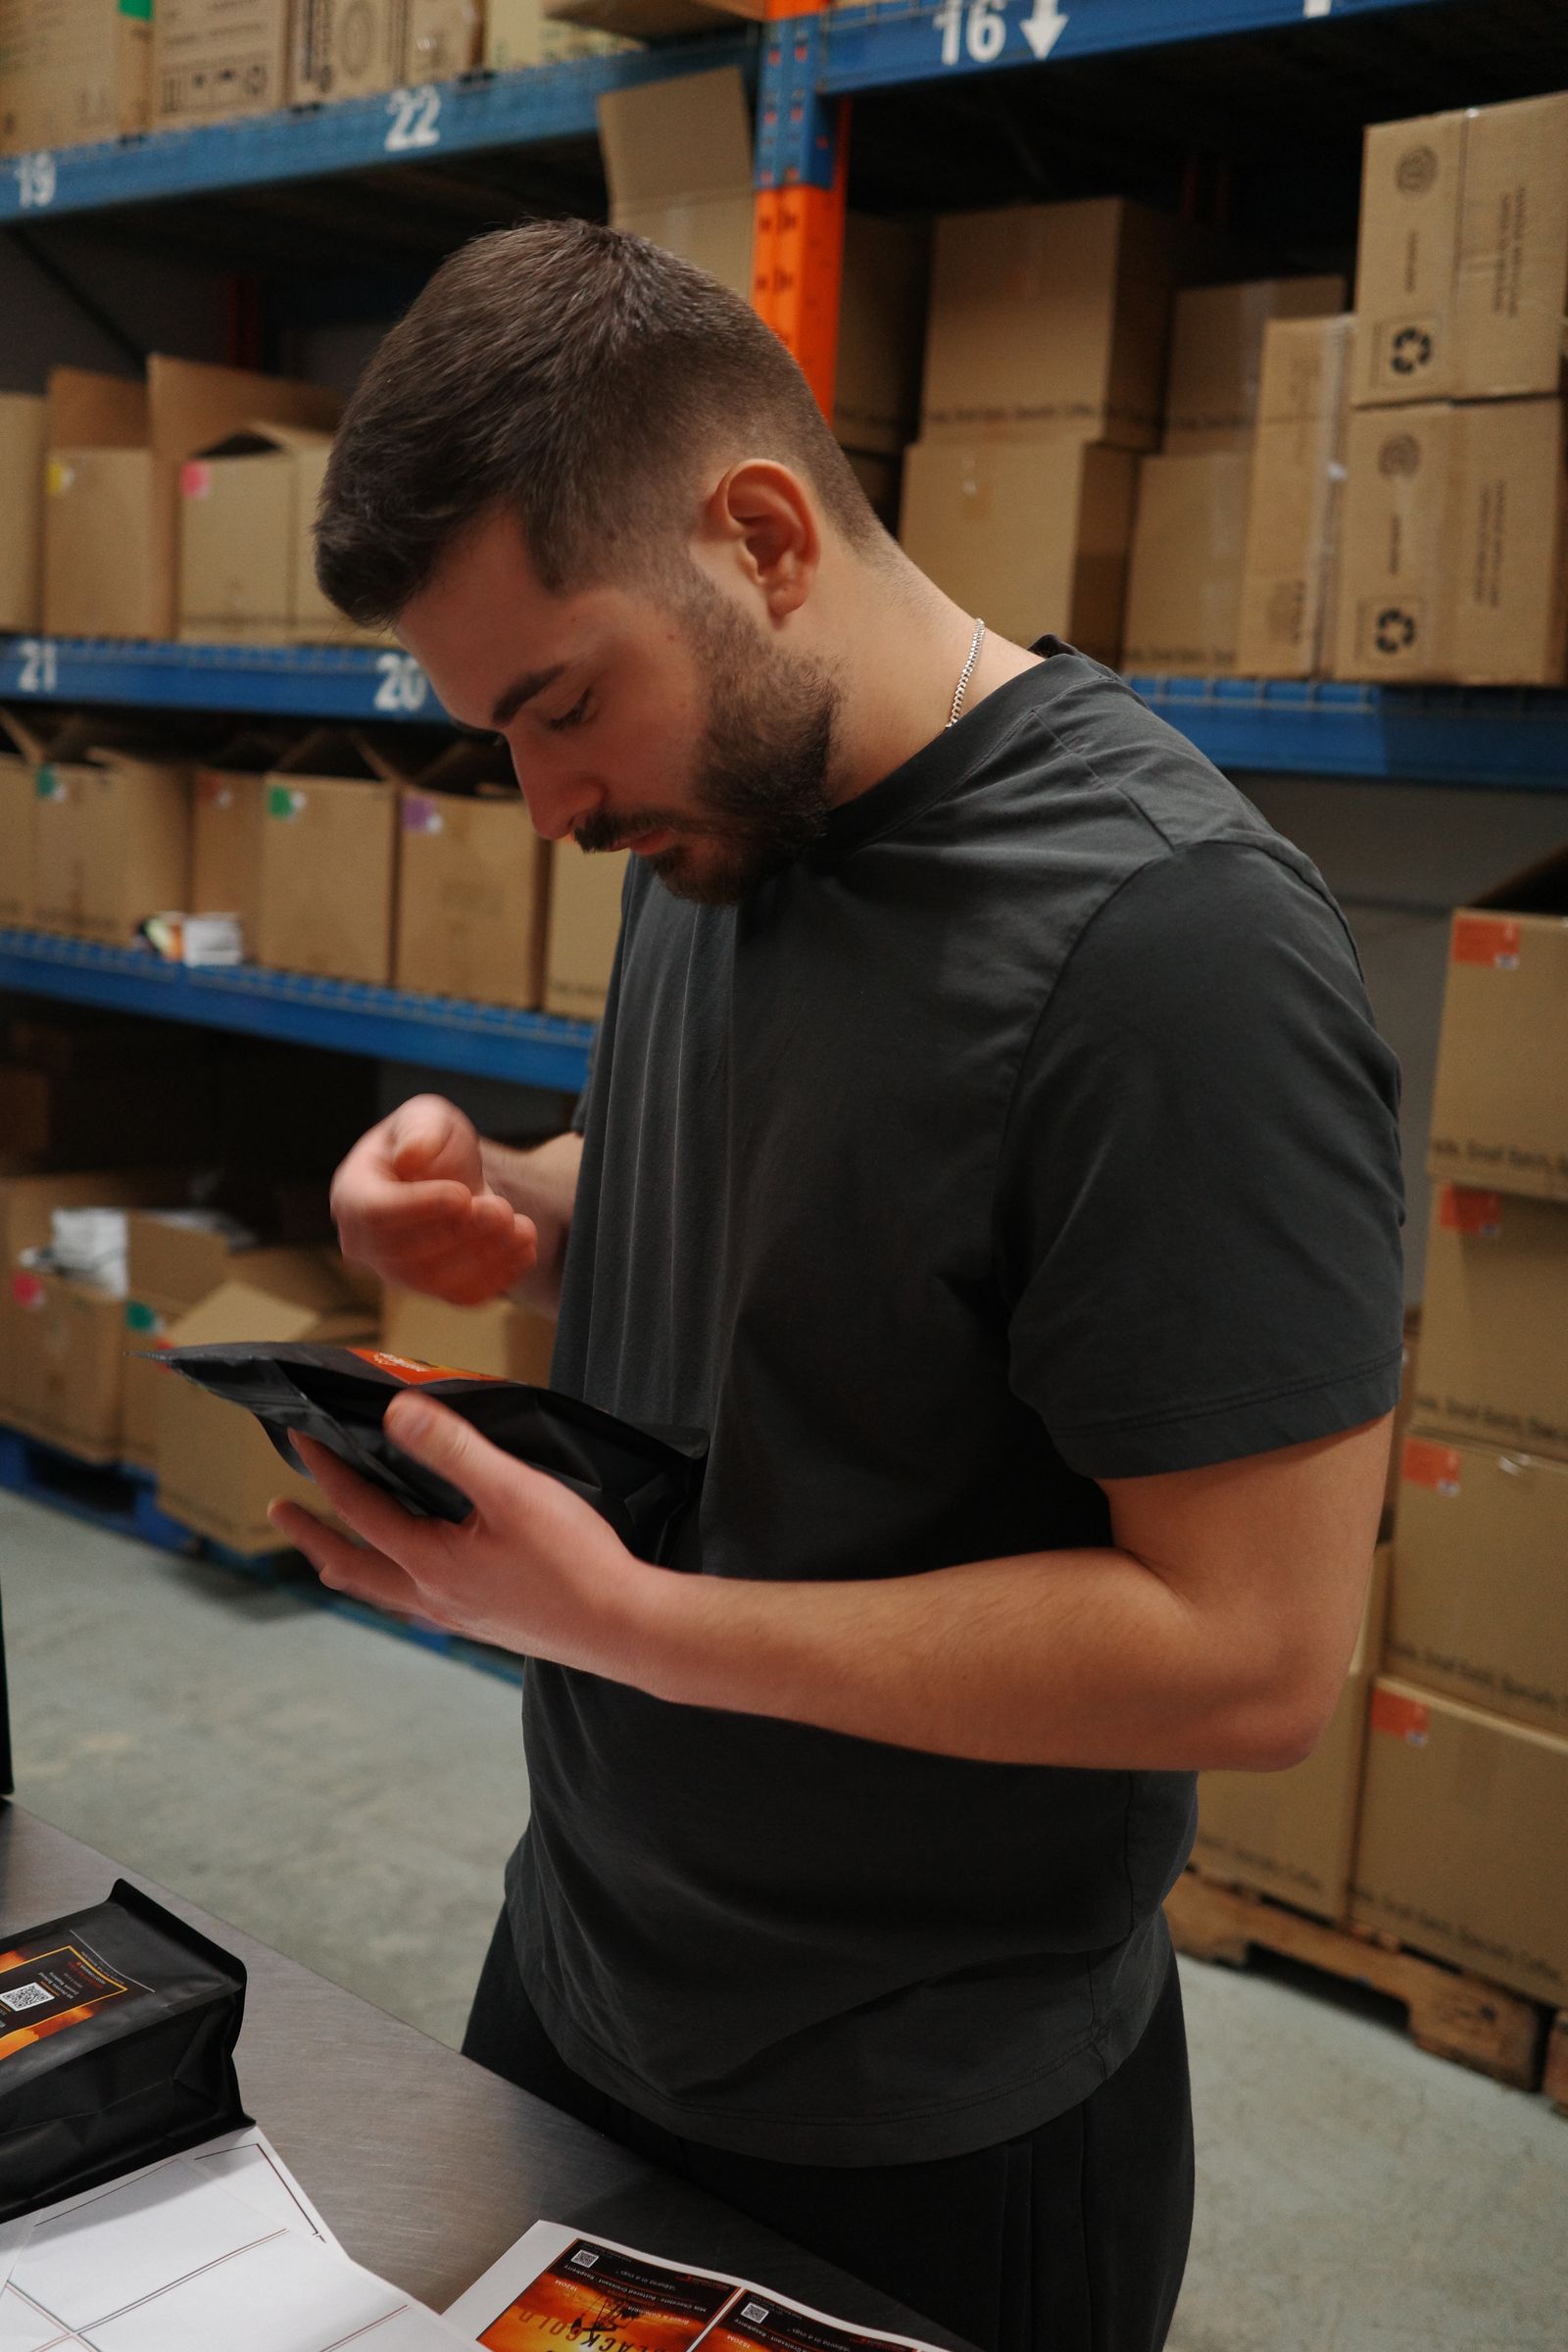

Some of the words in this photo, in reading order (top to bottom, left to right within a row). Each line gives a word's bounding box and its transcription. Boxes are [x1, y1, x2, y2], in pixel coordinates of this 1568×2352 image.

[932, 0, 1006, 66] 16
[384, 84, 441, 152] 22
[16, 152, 57, 207] 19
[17, 640, 58, 693] 21
[373, 653, 426, 711] 20
[564, 2265, 595, 2280] Raspberry
[598, 2278, 628, 2293] Croissant
[628, 2288, 657, 2301] Buttered
[661, 2297, 692, 2310] Chocolate
[733, 2318, 766, 2337] Raspberry
